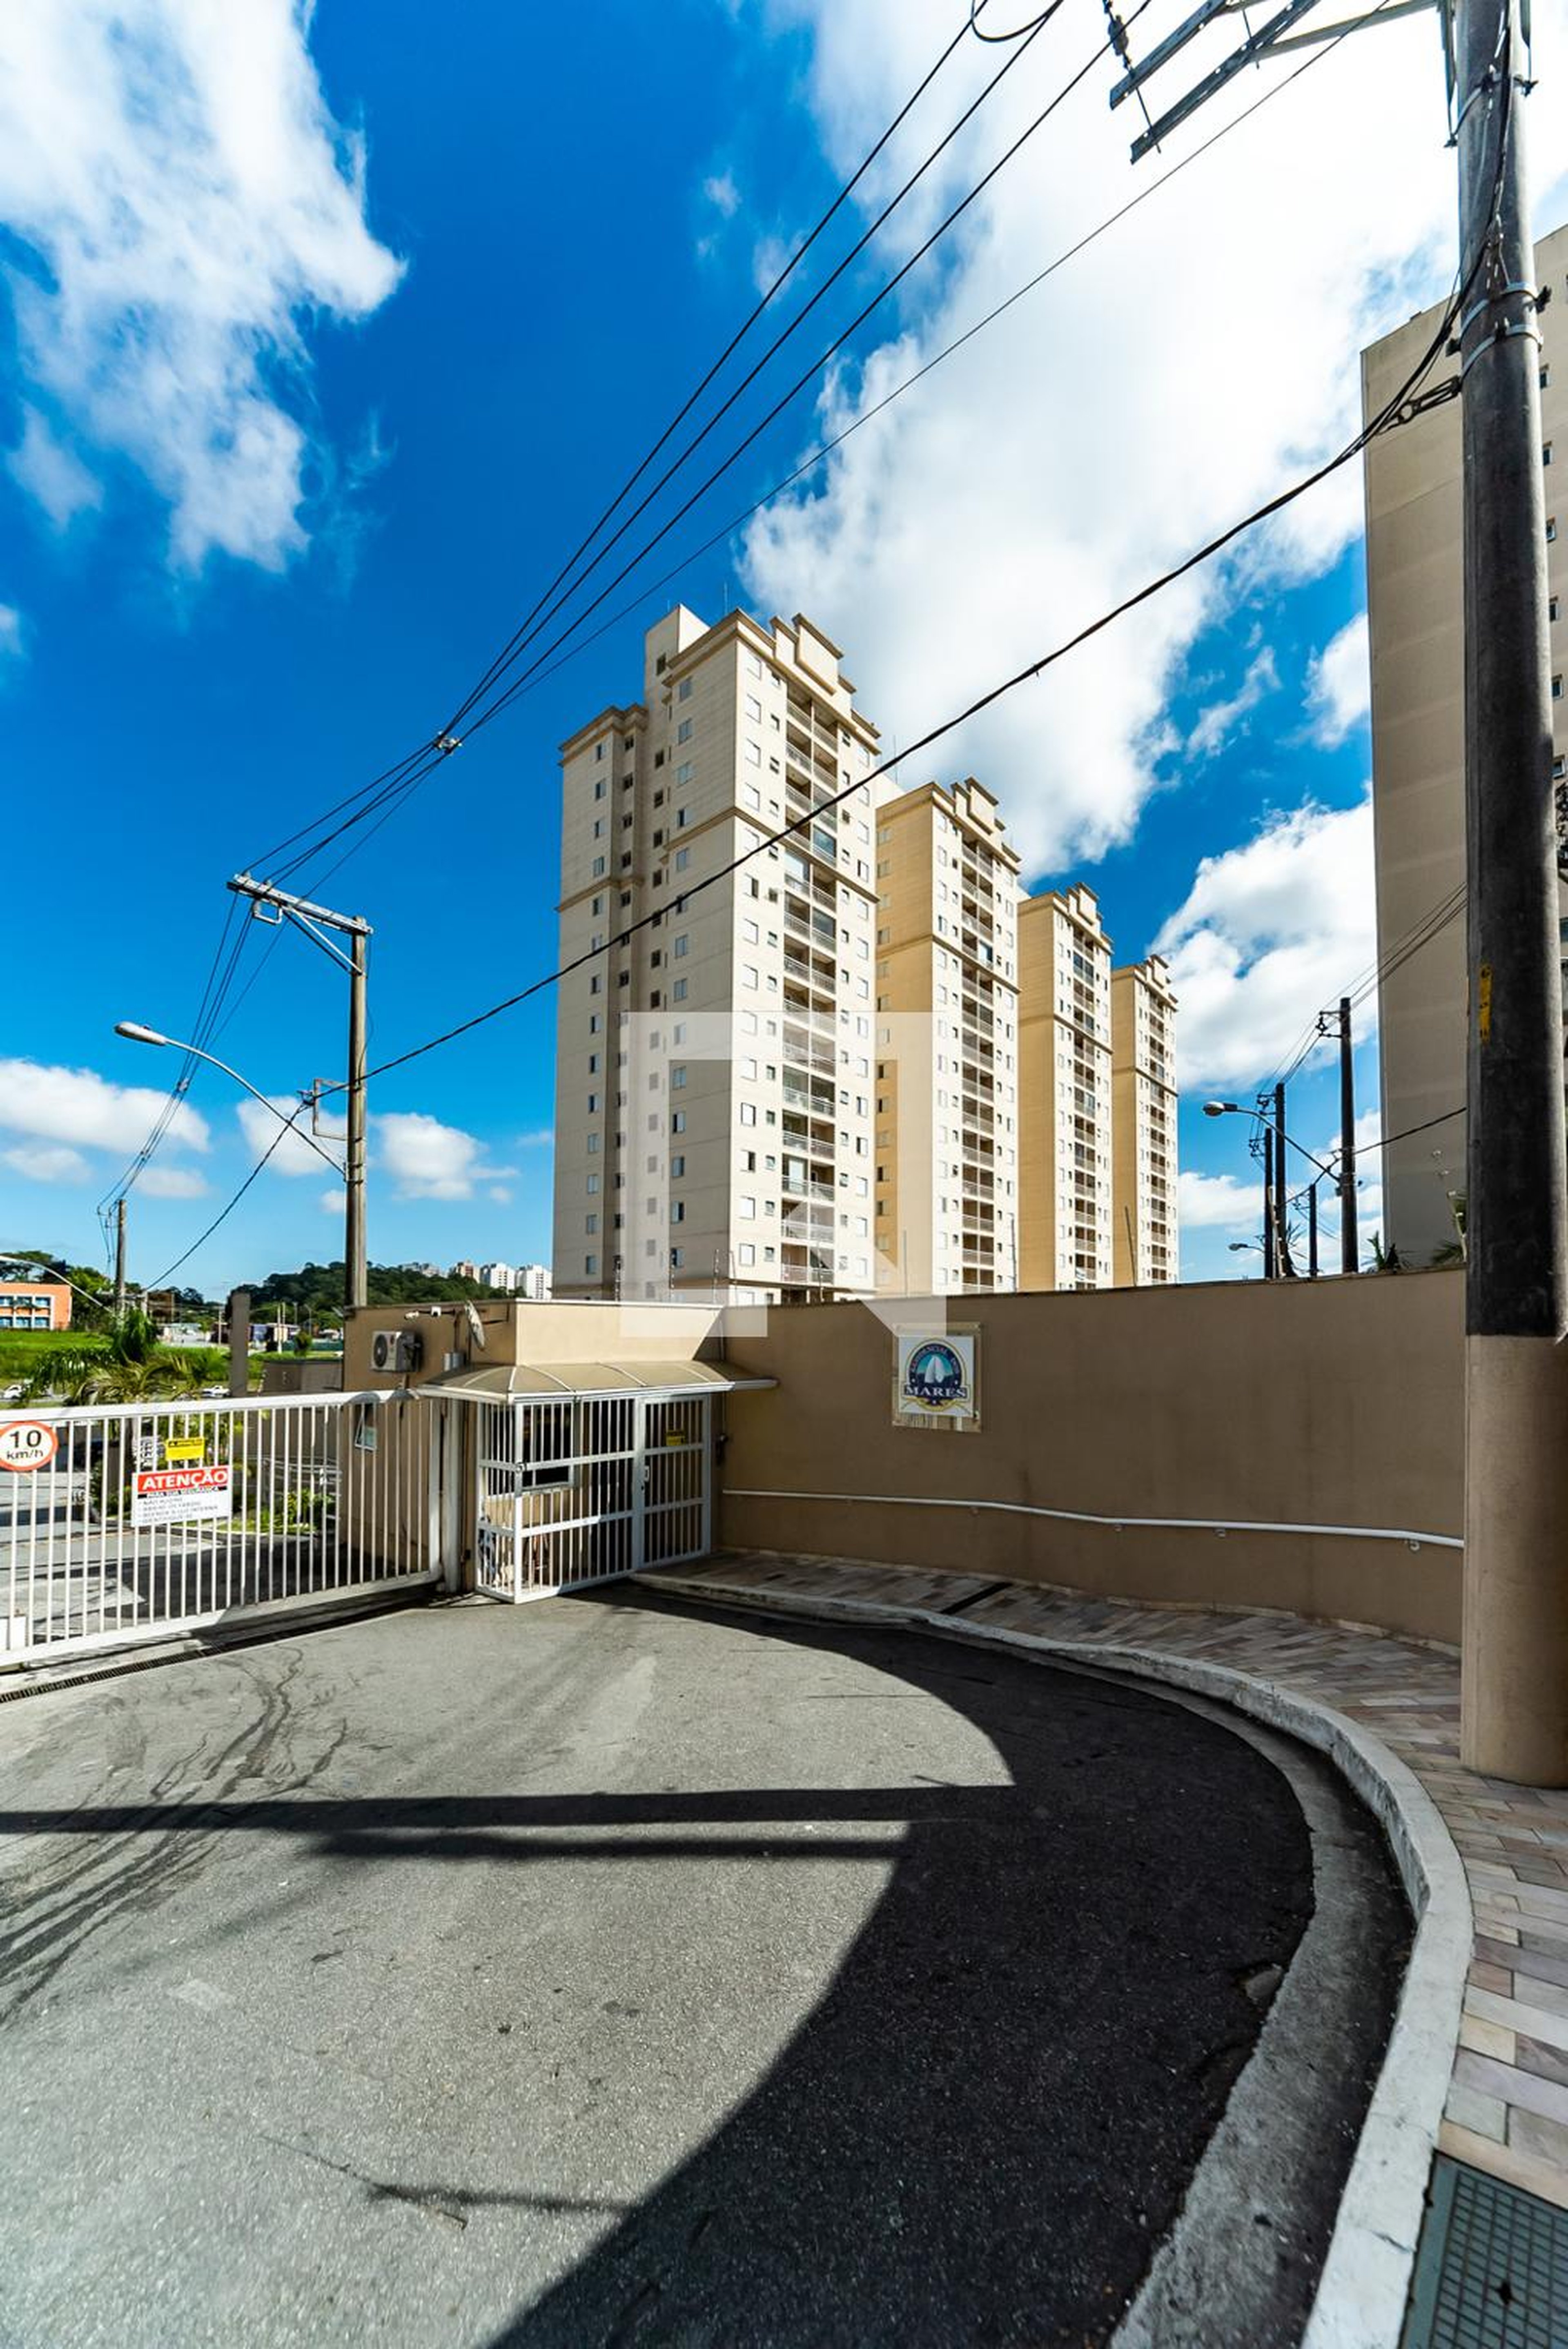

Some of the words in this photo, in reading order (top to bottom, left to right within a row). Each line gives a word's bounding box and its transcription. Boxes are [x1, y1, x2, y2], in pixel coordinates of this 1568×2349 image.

[906, 1386, 967, 1397] MARES
[9, 1430, 42, 1448] 10
[7, 1449, 44, 1460] km/h
[142, 1469, 228, 1490] ATENÇÃO
